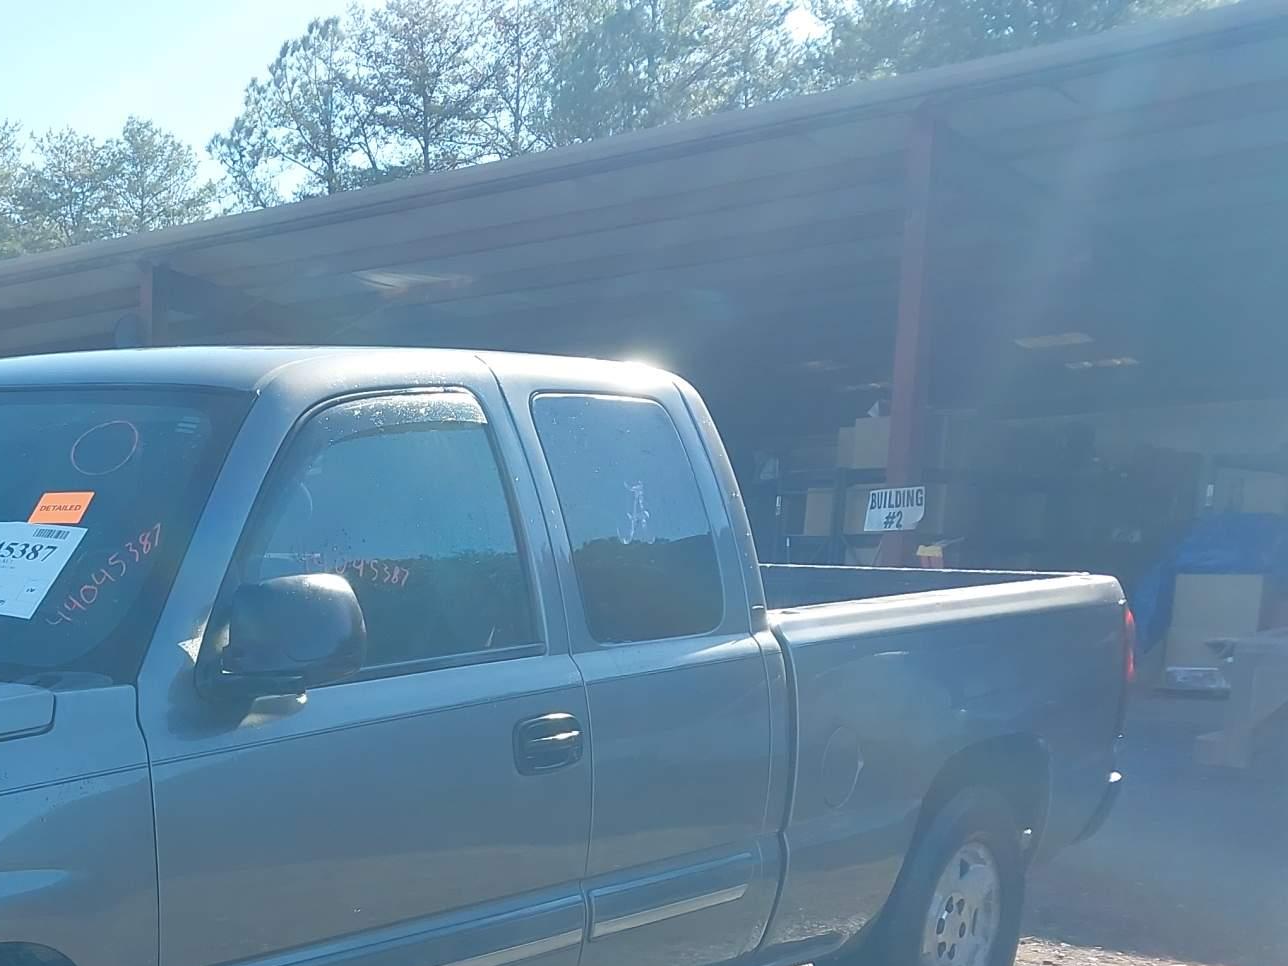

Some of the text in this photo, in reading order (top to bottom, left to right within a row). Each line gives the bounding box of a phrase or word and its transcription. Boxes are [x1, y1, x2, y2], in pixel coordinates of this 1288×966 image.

[39, 503, 82, 512] DETAILED
[870, 489, 924, 510] BUILDING
[883, 510, 903, 529] #2
[48, 523, 162, 625] 44045387
